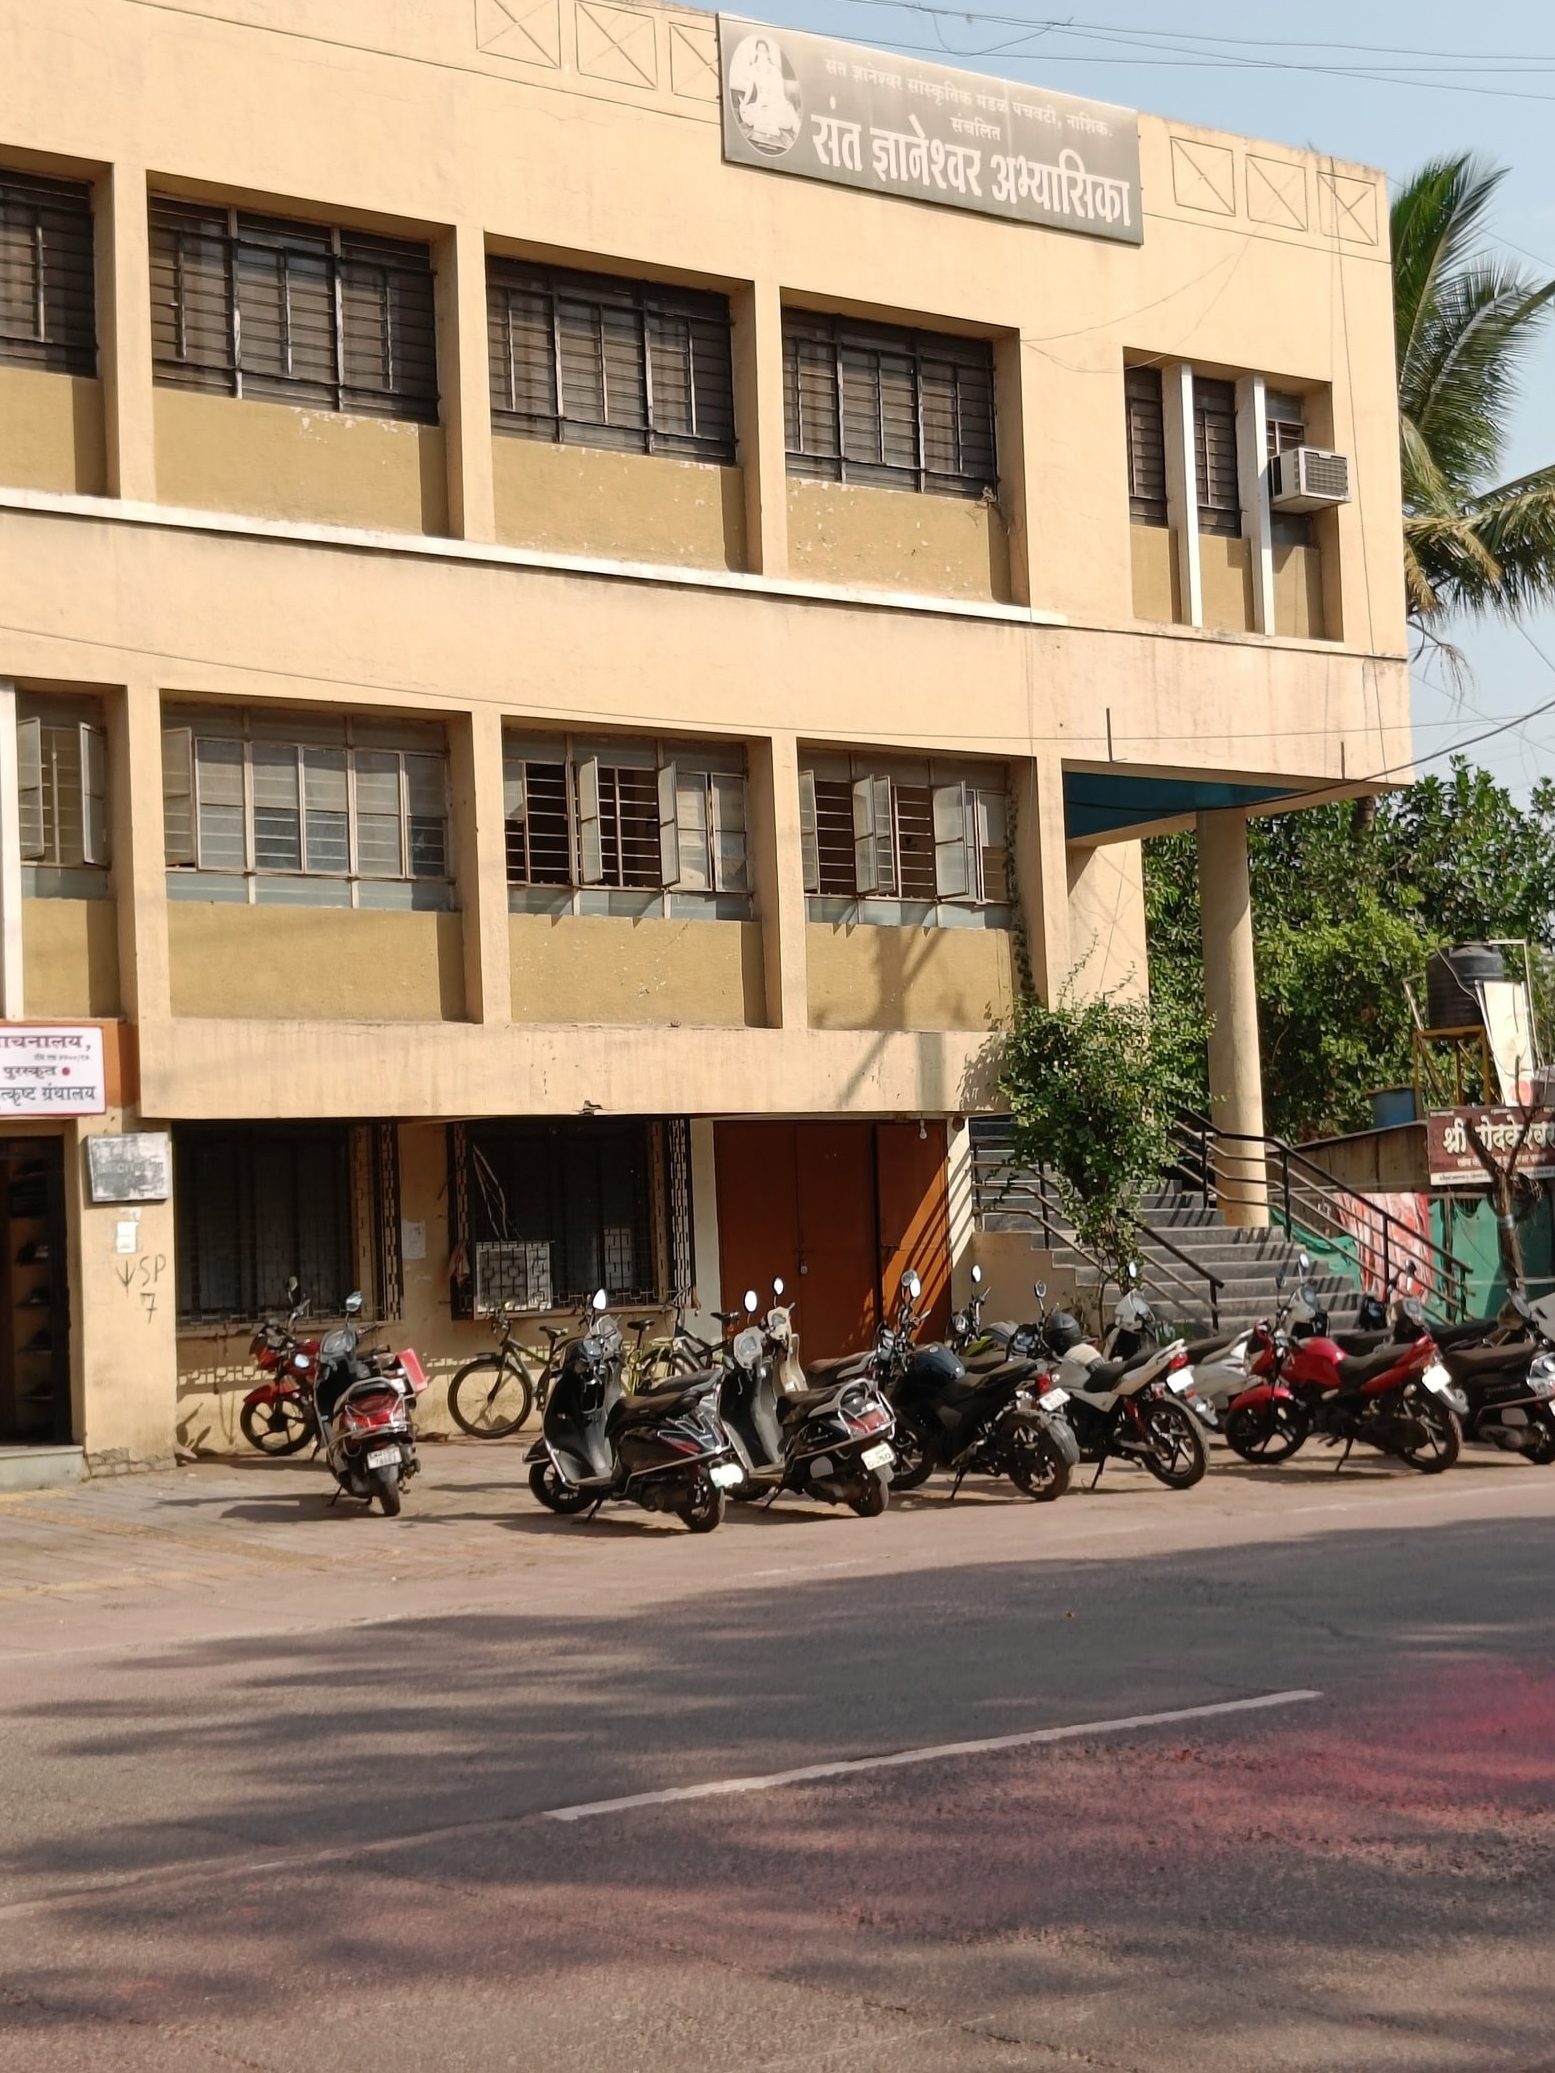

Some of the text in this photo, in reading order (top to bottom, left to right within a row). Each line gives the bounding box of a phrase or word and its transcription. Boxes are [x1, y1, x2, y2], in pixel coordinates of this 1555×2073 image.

[851, 61, 902, 90] ज्ञानेश्वर
[908, 74, 972, 106] सांस्कृतिक
[976, 88, 1009, 113] मंडळ
[950, 112, 1001, 141] संचलित
[811, 96, 1132, 227] संत ज्ञानेश्वर अभ्यासिका
[0, 1035, 91, 1051] ाचनालय,
[3, 1066, 57, 1080] पुरस्कृत
[0, 1082, 96, 1106] त्कृष्ट ग्रंथालय
[1442, 1117, 1467, 1154] श्री
